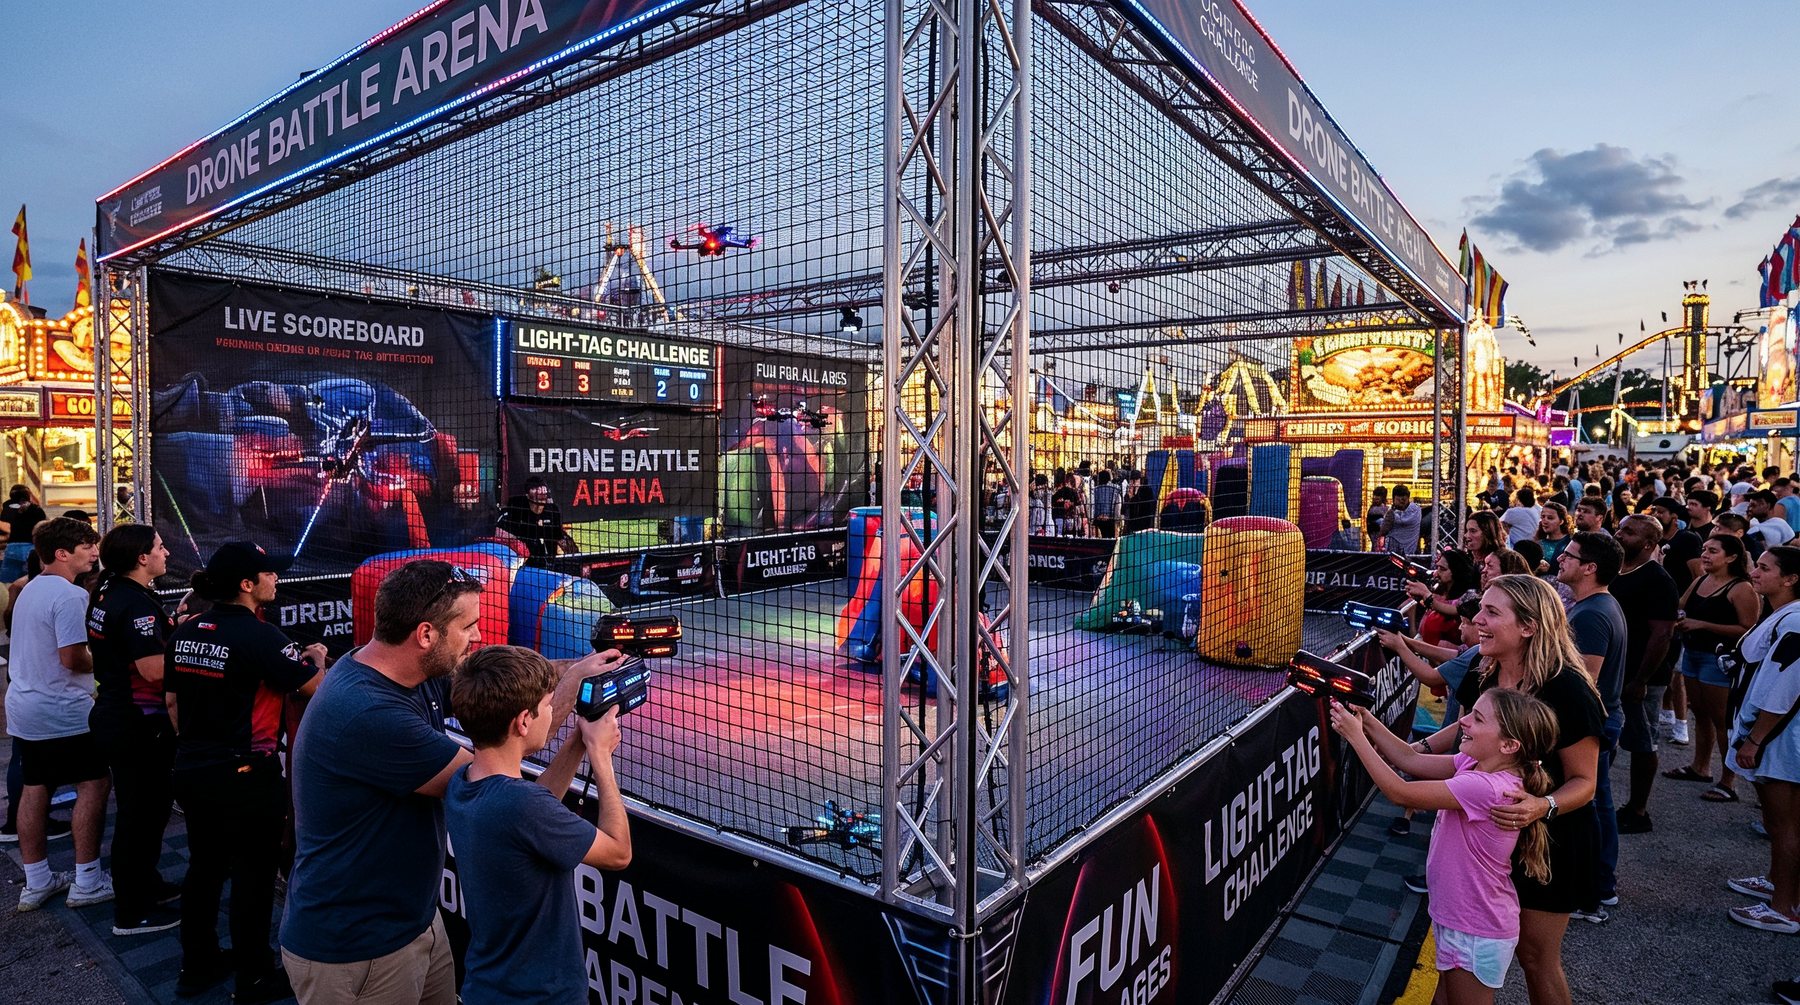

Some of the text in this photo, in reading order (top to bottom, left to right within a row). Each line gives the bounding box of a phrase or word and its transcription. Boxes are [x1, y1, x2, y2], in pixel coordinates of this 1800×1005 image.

[186, 0, 549, 205] DRONE BATTLE ARENA
[1288, 87, 1349, 192] DRONE
[1350, 160, 1395, 240] BATTLE
[224, 306, 277, 333] LIVE
[282, 312, 425, 348] SCOREBOARD
[518, 327, 710, 366] LIGHT-TAG CHALLENGE
[577, 374, 589, 393] 3
[657, 380, 667, 398] 2
[689, 383, 699, 400] 0
[528, 448, 700, 473] DRONE BATTLE
[572, 477, 665, 507] ARENA
[1330, 572, 1361, 588] ALL
[1204, 725, 1321, 885] LIGHT-TAG
[1223, 790, 1314, 921] CHALLENGE
[573, 862, 812, 1005] BATTLE
[1065, 861, 1160, 1005] FUN
